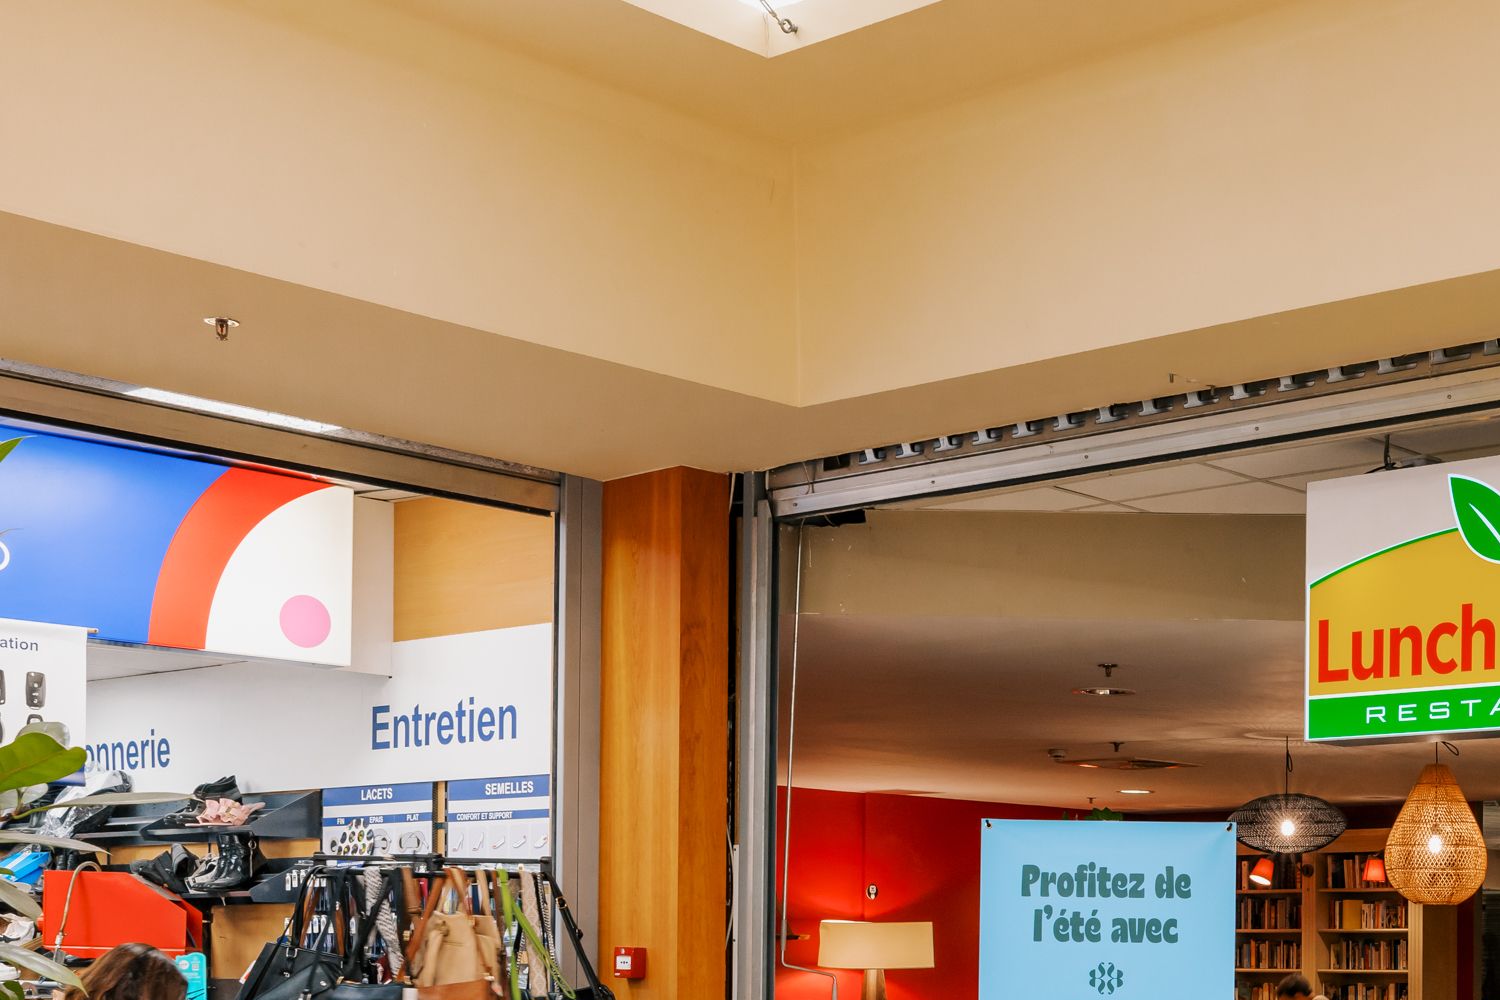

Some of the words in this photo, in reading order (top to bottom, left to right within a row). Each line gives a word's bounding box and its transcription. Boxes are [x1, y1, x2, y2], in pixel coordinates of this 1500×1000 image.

[1317, 603, 1496, 683] Lunch
[371, 696, 518, 751] Entretien
[361, 787, 393, 801] LACETS
[485, 780, 534, 797] SEMELLES
[406, 813, 419, 821] PLAT
[456, 812, 480, 821] CONFORT
[481, 812, 488, 820] ET
[489, 811, 513, 820] SUPPORT
[1021, 861, 1145, 899] Profitez
[1154, 866, 1192, 899] de
[1033, 904, 1101, 943] l'été
[1111, 917, 1179, 944] avec
